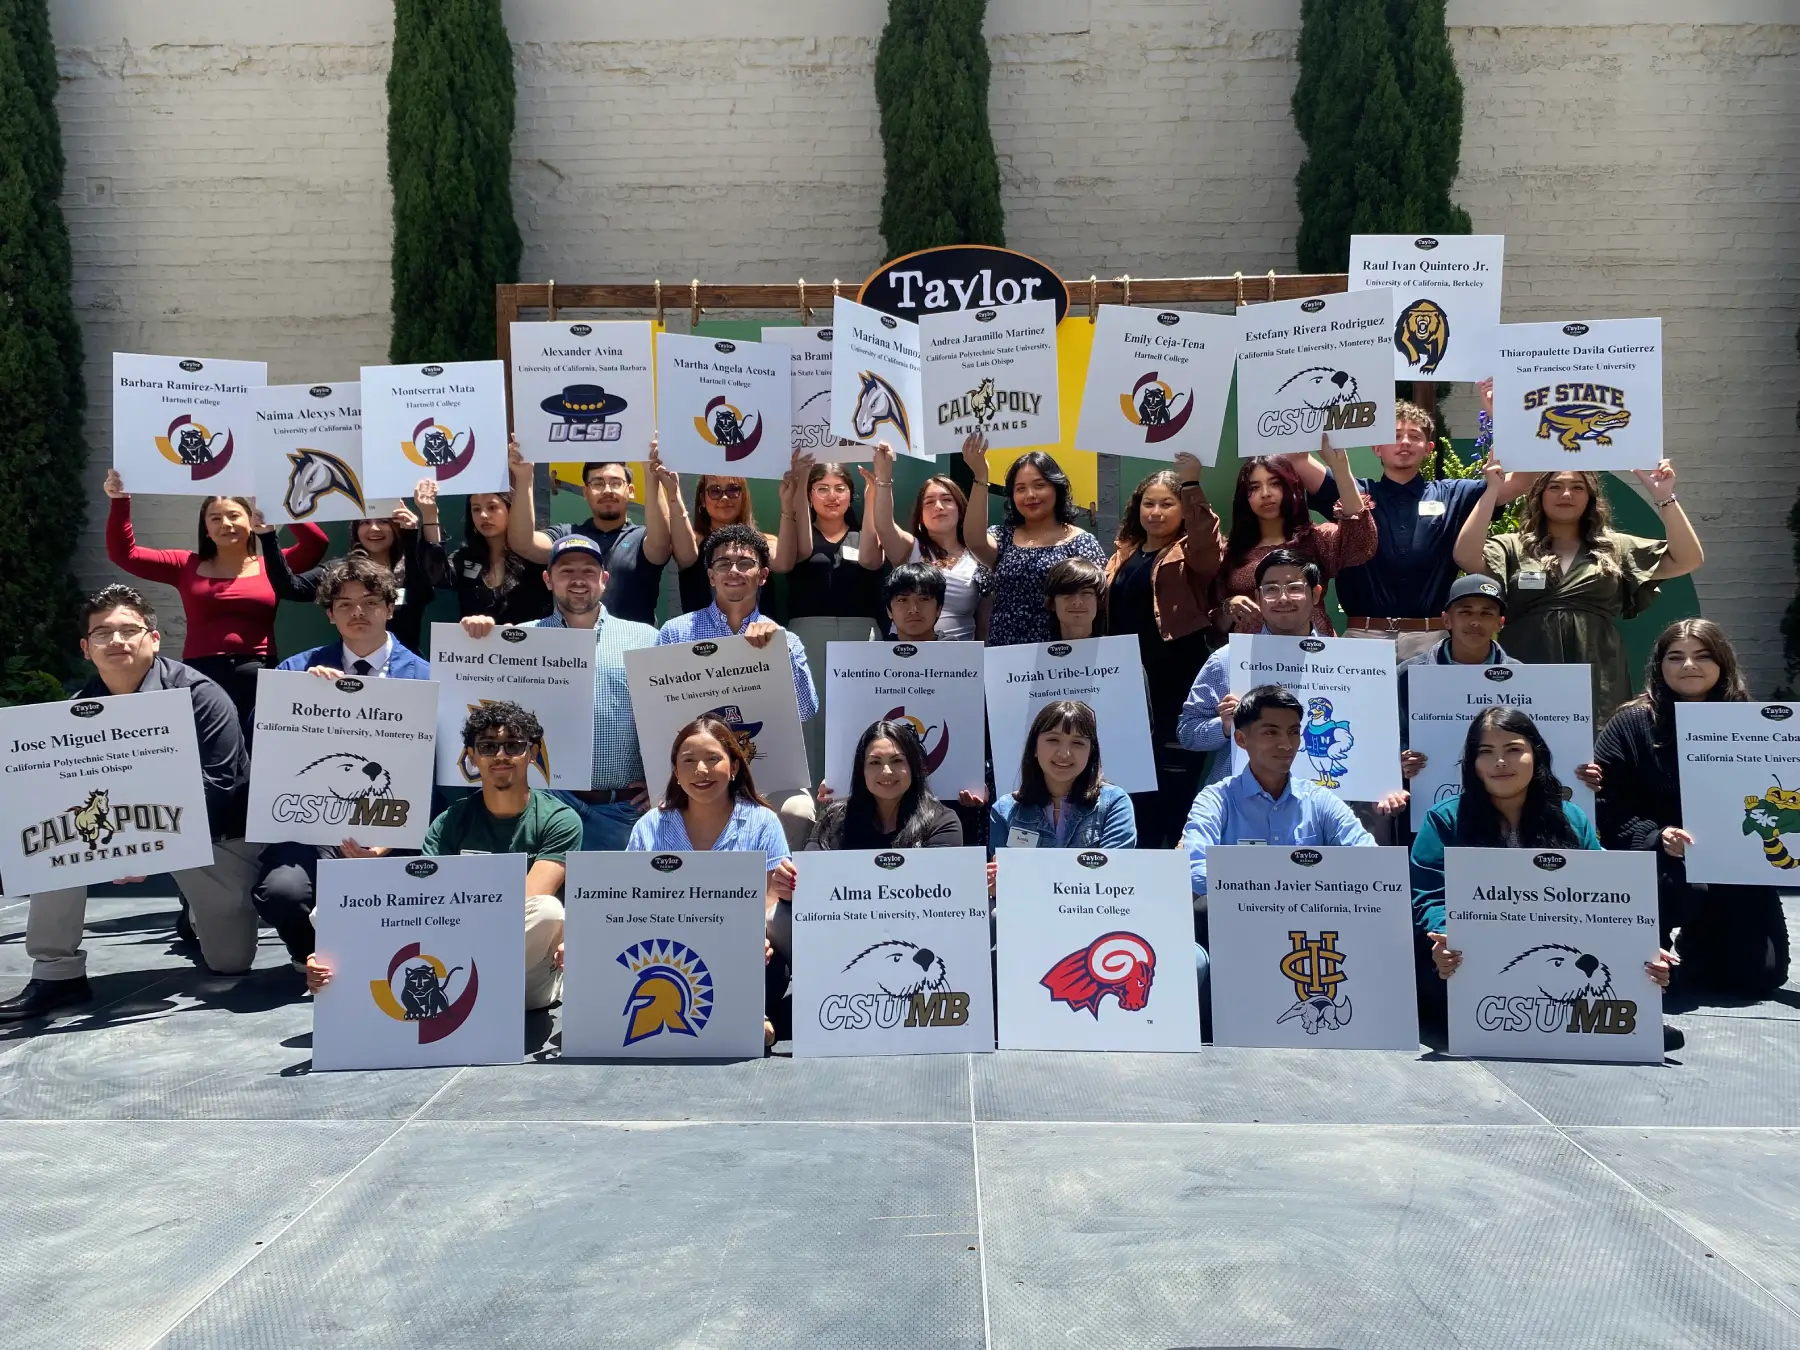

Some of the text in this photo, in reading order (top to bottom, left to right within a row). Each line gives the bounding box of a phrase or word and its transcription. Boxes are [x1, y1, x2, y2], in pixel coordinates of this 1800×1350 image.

[1364, 261, 1488, 273] Raul Ivan Quintero Jr.
[890, 270, 1042, 310] Taylor
[931, 327, 1044, 346] Andrea Jaramillo Martinez
[1246, 318, 1384, 341] Estefany Rivera Rodriguez
[853, 327, 890, 349] Mariana
[1125, 333, 1205, 350] Emily Ceja-Tena
[542, 347, 623, 356] Alexander Avina
[1499, 345, 1654, 358] Thiaropaulette Davila Gutierrez
[674, 359, 775, 376] Martha Angela Acosta
[121, 378, 163, 388] Barbara
[392, 387, 445, 396] Montserrat
[1523, 382, 1624, 410] SF STATE
[256, 409, 335, 421] Naima Alexys
[938, 391, 1042, 426] CAL POLY
[1258, 401, 1376, 437] CSUMB
[548, 422, 623, 442] UCSB
[954, 420, 1028, 435] MUSTANGS
[439, 652, 587, 668] Edward Clement Isabella
[649, 662, 770, 686] Salvador Valenzuela
[833, 669, 978, 678] Valentino Corona-Hernandez
[1007, 666, 1119, 683] Joziah Uribe-Lopez
[1240, 661, 1386, 676] Carlos Daniel Ruiz Cervantes
[456, 674, 494, 683] University
[507, 676, 545, 684] California
[682, 690, 719, 700] University
[732, 685, 762, 693] Arizona
[908, 687, 935, 695] College
[1029, 687, 1100, 698] Stanford University
[1275, 682, 1350, 693] National University
[1467, 694, 1532, 707] Luis Mejia
[292, 703, 403, 722] Roberto Alfaro
[1528, 714, 1590, 725] Monterey Bay
[256, 722, 299, 732] California
[302, 725, 324, 733] State
[328, 727, 372, 738] University,
[375, 730, 414, 739] Monterey
[1686, 733, 1728, 741] Jasmine
[1732, 733, 1769, 741] Evenne
[11, 726, 169, 753] Jose Miguel Becerra
[5, 761, 51, 773] California
[54, 754, 104, 767] Polytechnic
[132, 746, 178, 757] University,
[1687, 754, 1734, 762] California
[1737, 754, 1762, 762] State
[80, 768, 99, 776] Luis
[101, 765, 132, 773] Obispo
[272, 793, 409, 827] CSUMB
[21, 803, 183, 857] CAL POLY
[51, 840, 164, 867] MUSTANGS
[878, 855, 901, 863] Taylor
[1081, 854, 1104, 863] Taylor
[1295, 852, 1318, 860] Taylor
[1538, 856, 1562, 864] Taylor
[655, 858, 678, 866] Taylor
[574, 887, 757, 899] Jazmine Ramirez Hernandez
[830, 884, 952, 900] Alma Escobedo
[1054, 882, 1134, 898] Kenia Lopez
[1215, 880, 1402, 894] Jonathan Javier Santiago Cruz
[340, 892, 502, 908] Jacob Ramirez Alvarez
[1472, 886, 1630, 905] Adalyss Solorzano
[795, 908, 987, 921] California State University, Monterey Bay
[1059, 905, 1130, 916] Gavilan College
[1238, 903, 1381, 914] University of California, Irvine
[381, 916, 460, 927] Hartnell College
[606, 914, 724, 925] San Jose State University
[1449, 911, 1656, 926] California State University, Monterey Bay
[819, 992, 970, 1031] CSUMB
[1476, 996, 1637, 1034] CSUMB
